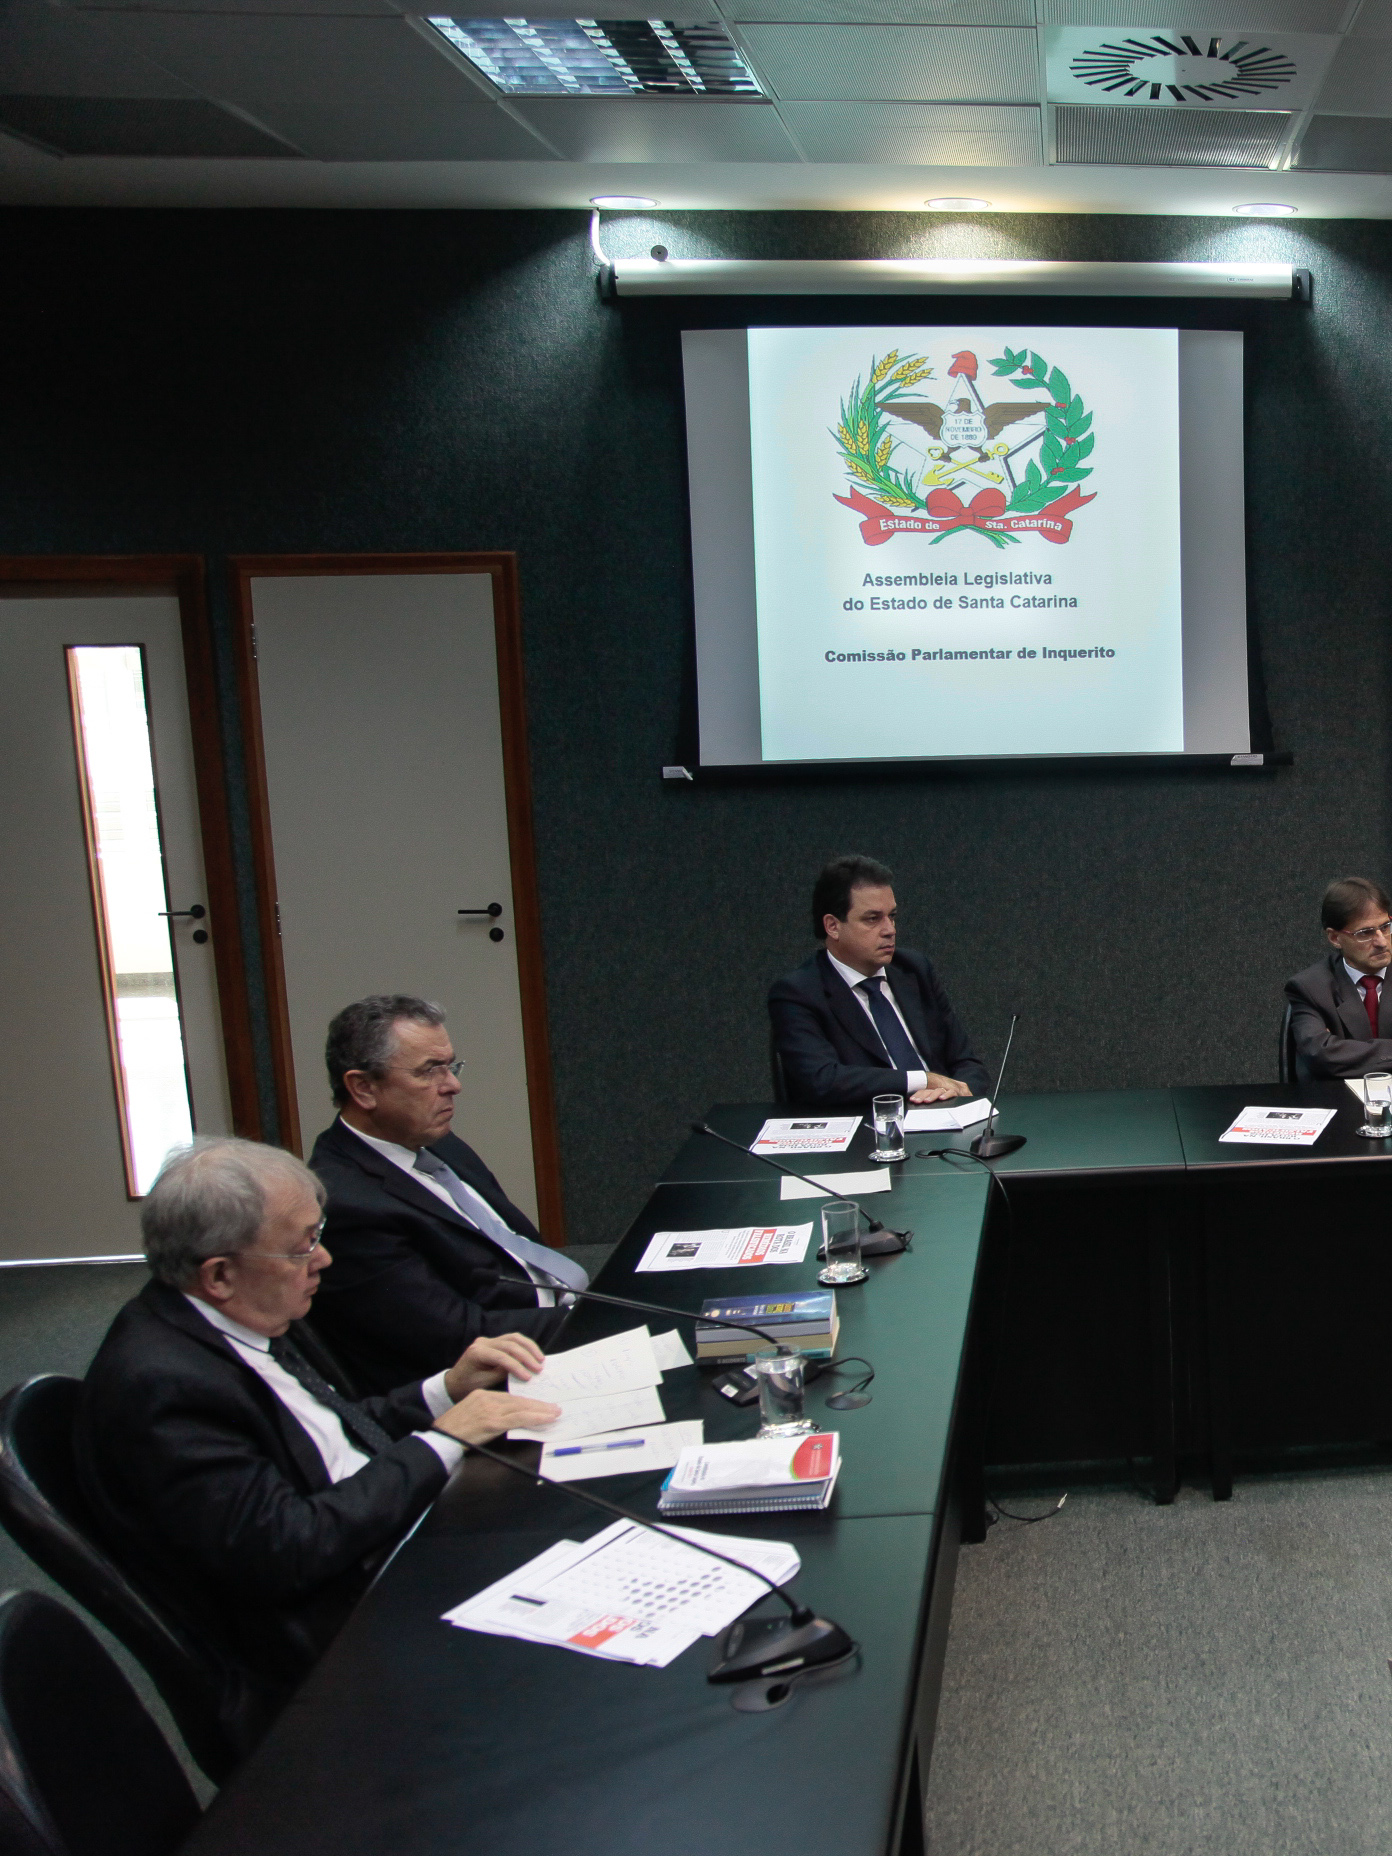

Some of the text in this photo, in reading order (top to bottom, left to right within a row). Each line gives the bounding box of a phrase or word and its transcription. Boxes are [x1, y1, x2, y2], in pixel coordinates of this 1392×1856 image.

[879, 518, 940, 531] Estado de
[985, 518, 1063, 531] Sta. Catarina
[862, 570, 1053, 589] Assembleia Legislativa
[842, 594, 1078, 612] do Estado de Santa Catarina
[824, 645, 1116, 663] Comissão Parlamentar de Inquerito
